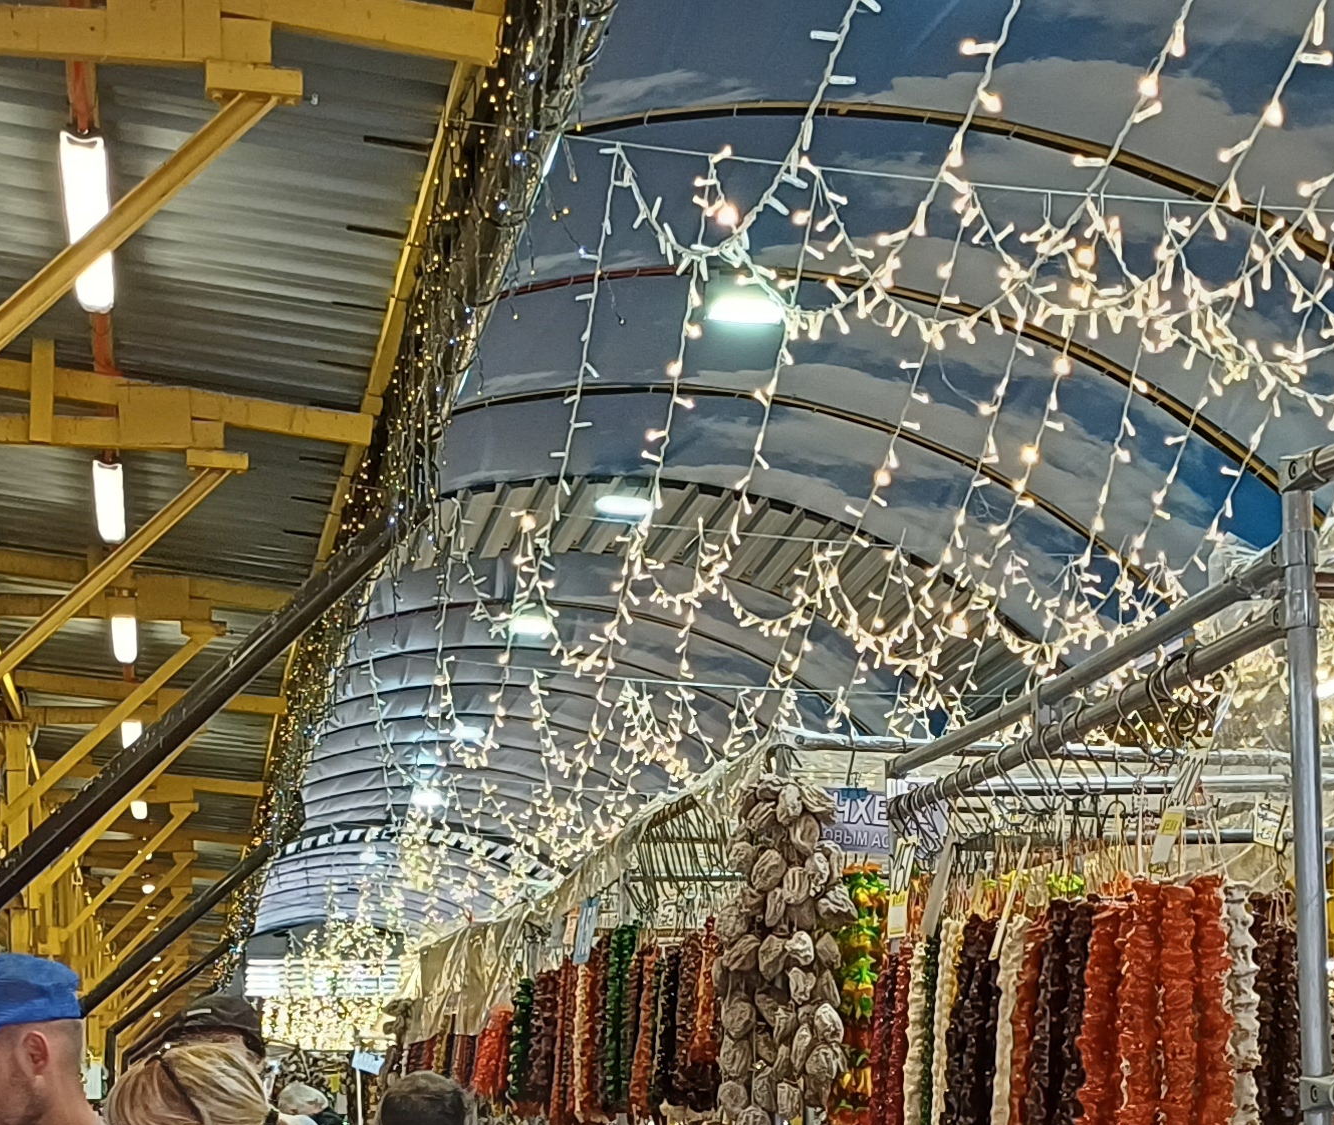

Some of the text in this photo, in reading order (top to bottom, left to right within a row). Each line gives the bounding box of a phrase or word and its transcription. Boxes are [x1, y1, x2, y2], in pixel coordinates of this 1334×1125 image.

[833, 792, 889, 827] ЧХЕ
[823, 829, 889, 848] ОВЫМ АС
